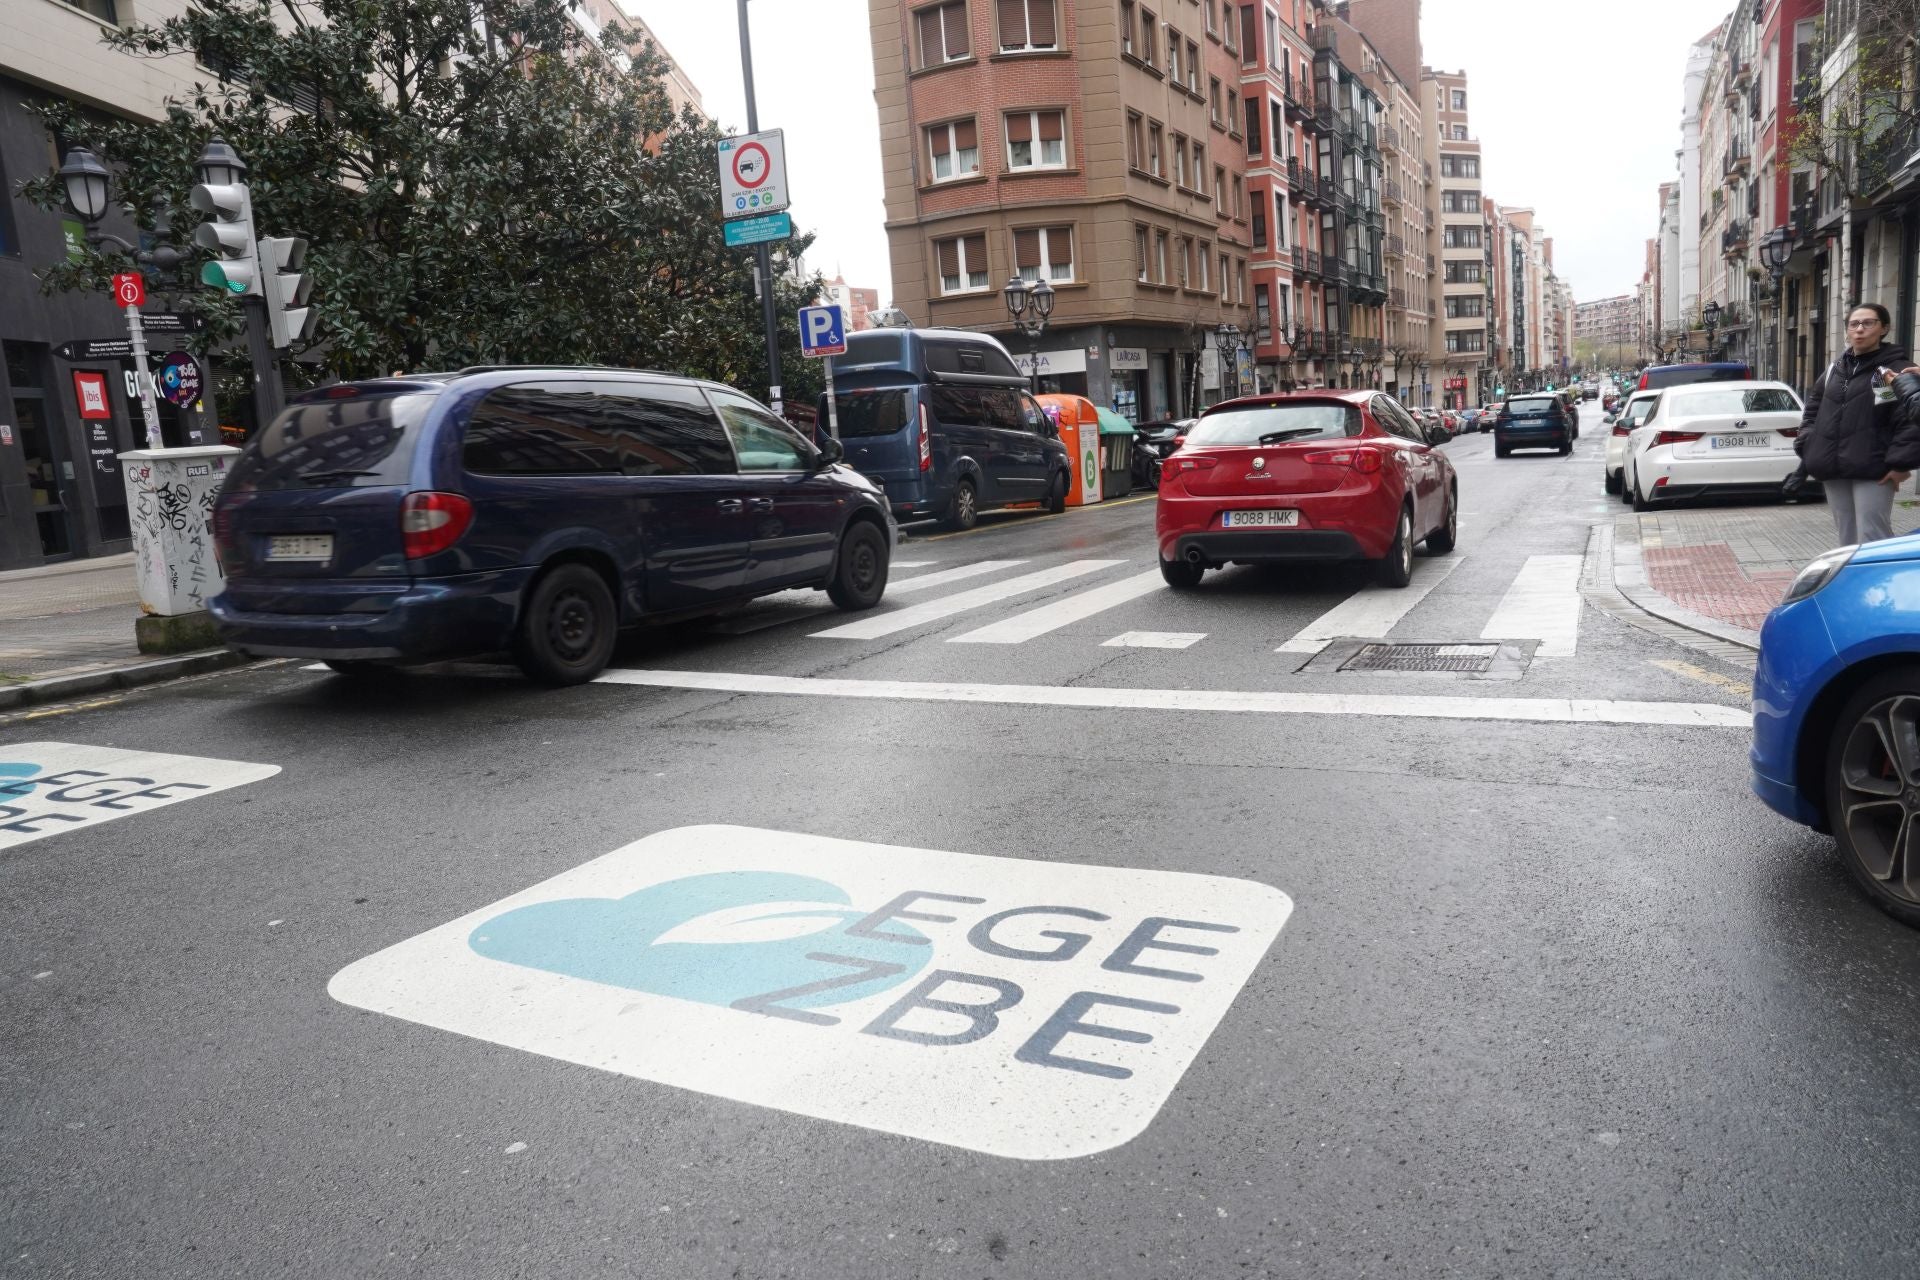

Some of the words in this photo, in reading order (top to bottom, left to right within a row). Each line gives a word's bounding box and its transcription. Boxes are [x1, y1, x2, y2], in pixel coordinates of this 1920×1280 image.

[807, 309, 833, 347] P
[85, 390, 100, 402] ibis
[1718, 437, 1744, 447] 0908
[1747, 436, 1768, 445] HVK
[188, 467, 208, 476] RUE
[1233, 512, 1264, 525] 9088
[1268, 511, 1292, 524] HMK
[843, 889, 1241, 984] EGE
[729, 951, 1182, 1080] ZBE
